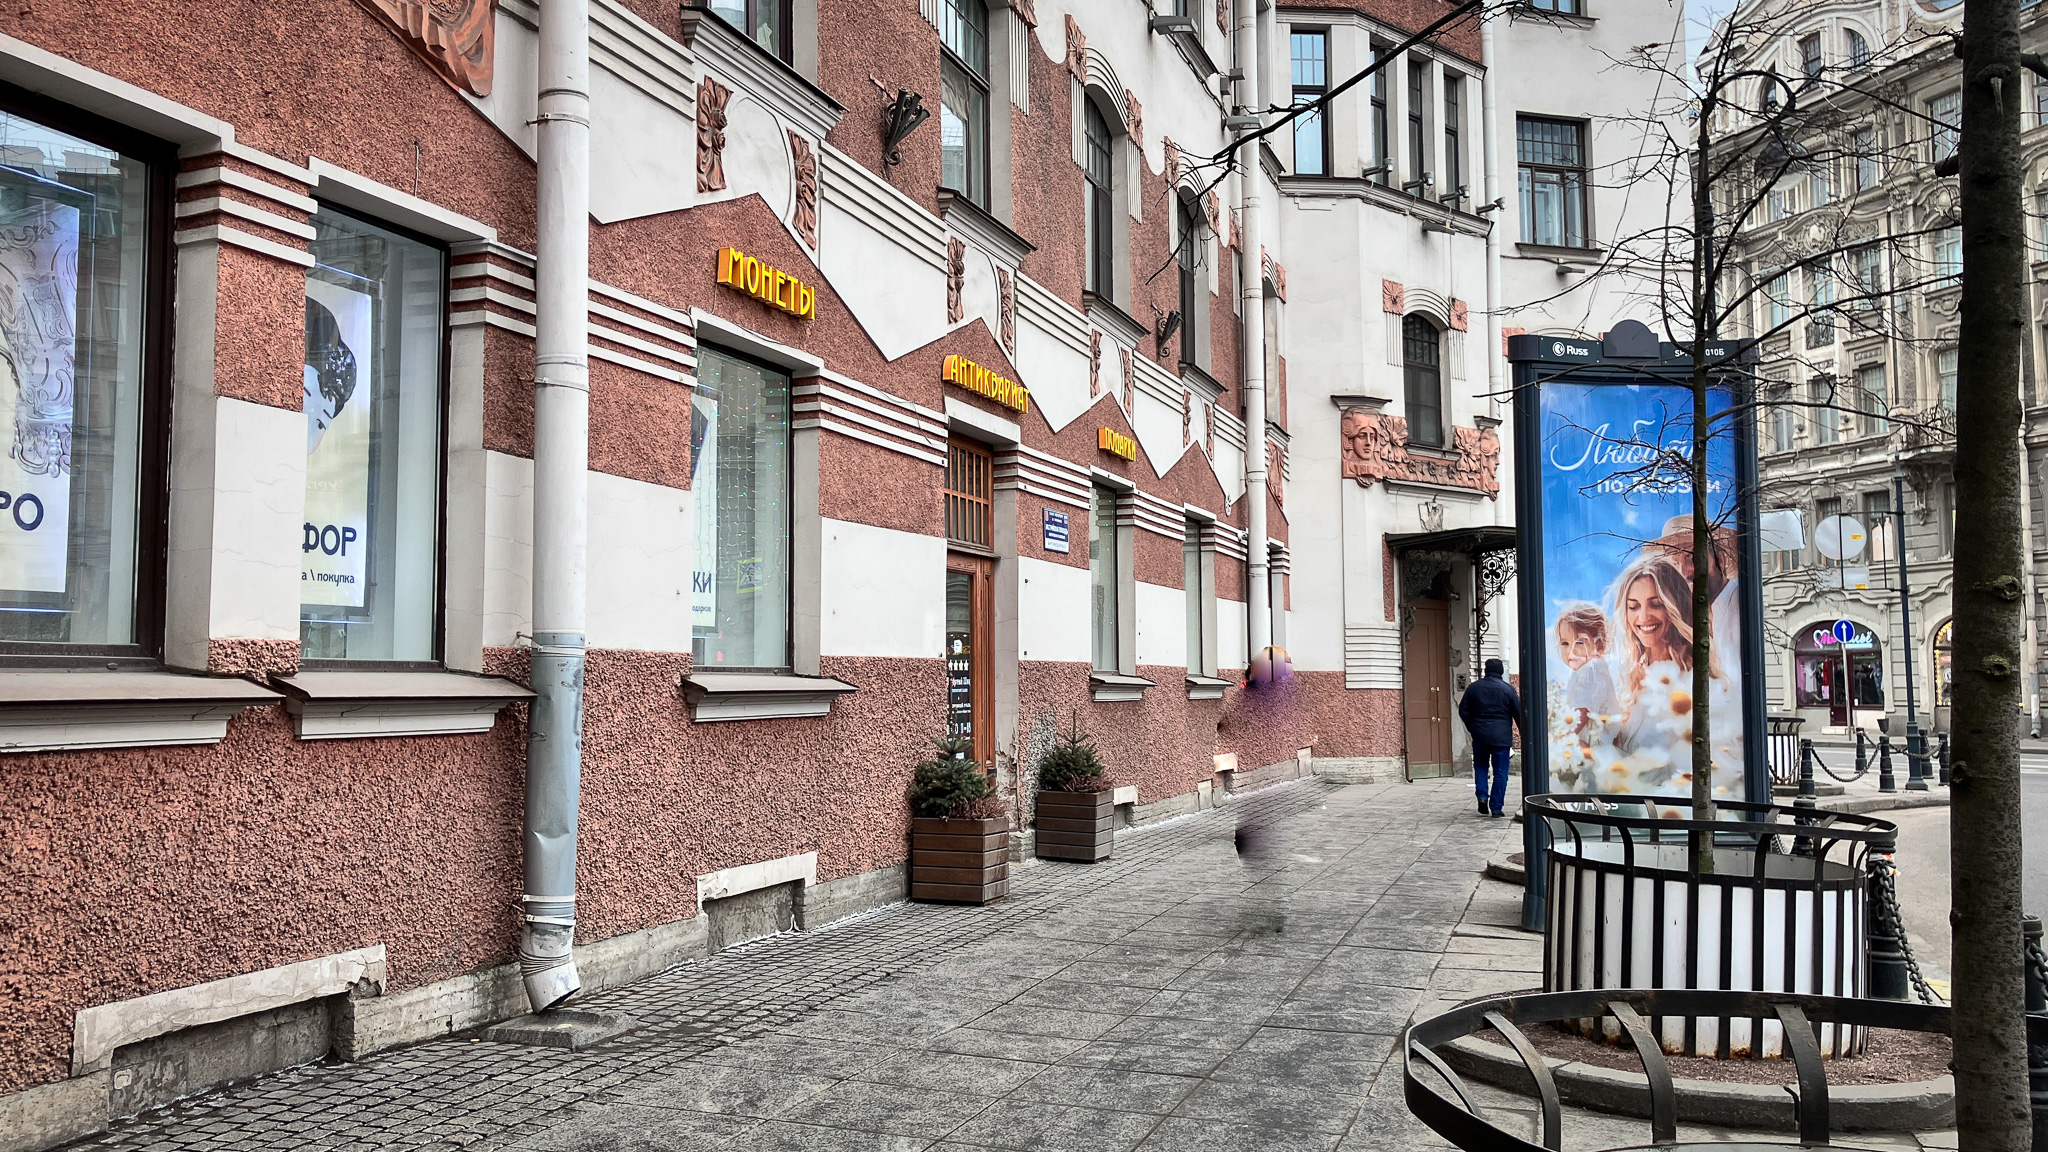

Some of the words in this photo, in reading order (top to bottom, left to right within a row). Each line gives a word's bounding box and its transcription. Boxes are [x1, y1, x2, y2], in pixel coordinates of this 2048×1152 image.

[726, 247, 815, 321] МОНЕТЫ
[1566, 345, 1589, 356] Russ
[949, 354, 1030, 414] АНТИКВАРИАТ
[1104, 426, 1137, 462] ПОДАРКИ
[317, 573, 355, 587] покупка
[692, 571, 712, 594] КИ
